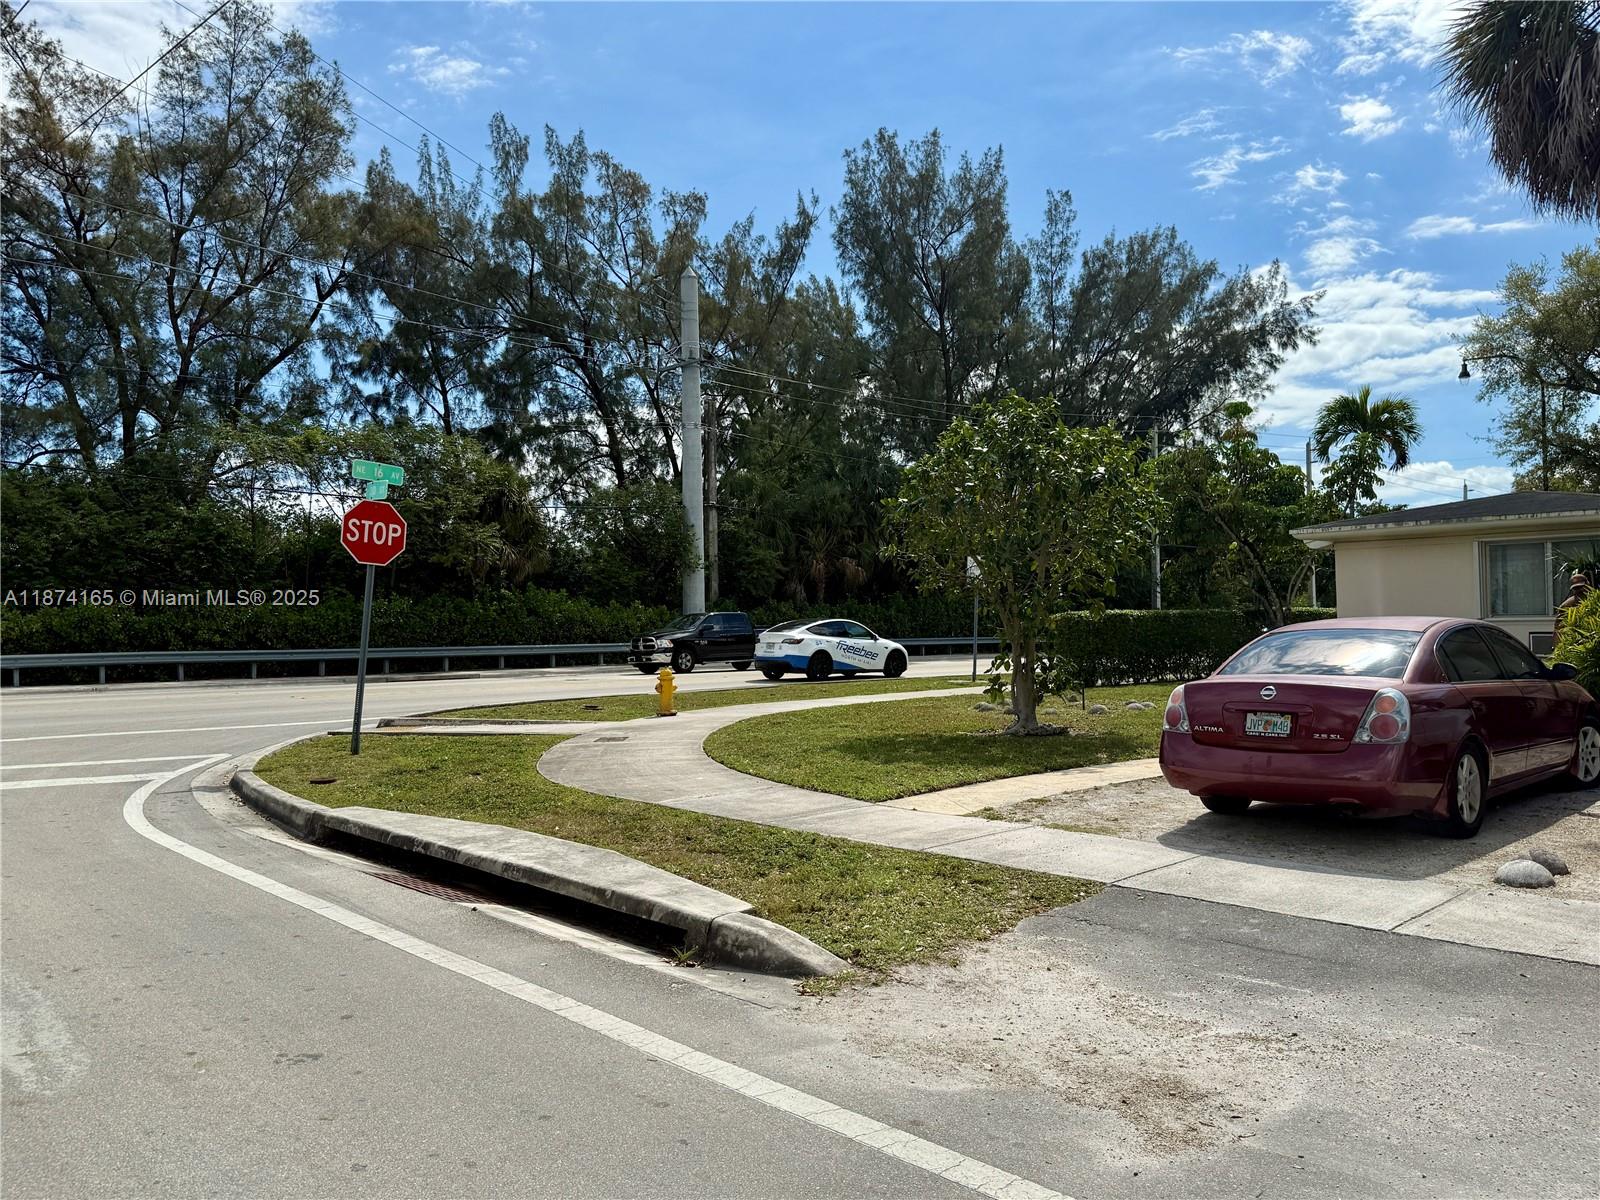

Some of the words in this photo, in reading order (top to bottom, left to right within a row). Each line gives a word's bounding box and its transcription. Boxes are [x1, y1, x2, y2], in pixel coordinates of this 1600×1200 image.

[356, 465, 366, 474] NE
[374, 467, 384, 478] 16
[391, 472, 400, 480] AV
[346, 518, 402, 546] STOP
[835, 640, 879, 661] freebee
[1193, 725, 1224, 733] ALTIMA
[1247, 719, 1263, 730] JVP
